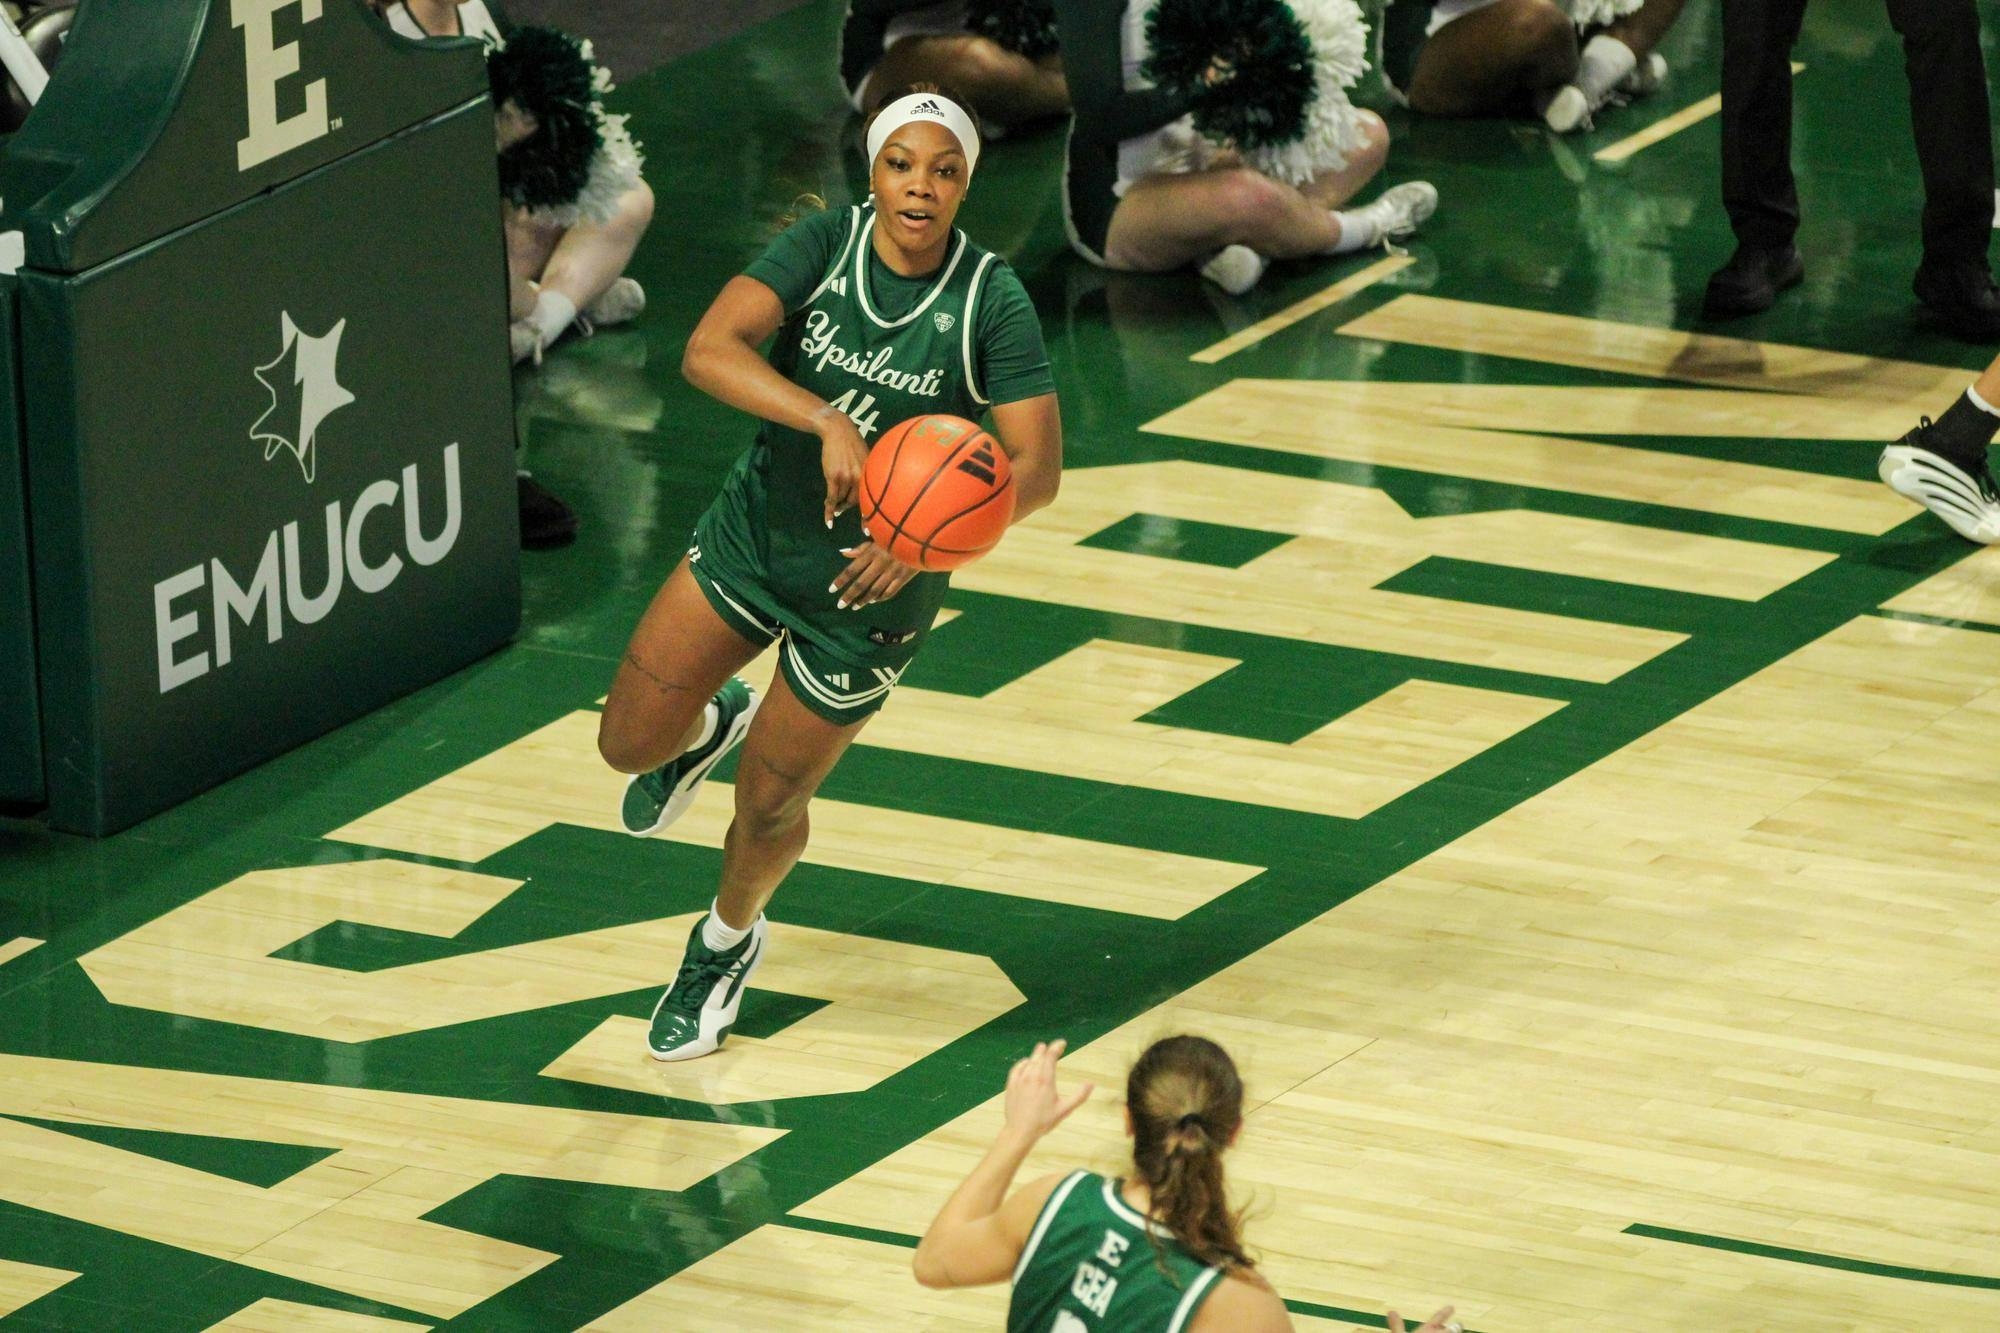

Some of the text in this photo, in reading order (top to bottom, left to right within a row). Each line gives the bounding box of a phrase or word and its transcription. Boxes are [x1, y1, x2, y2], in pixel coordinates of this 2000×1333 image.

[230, 0, 344, 173] E TM
[910, 107, 945, 118] adidas
[800, 310, 945, 397] Ypsilanti
[829, 388, 881, 439] 14
[154, 442, 462, 694] EMUCU
